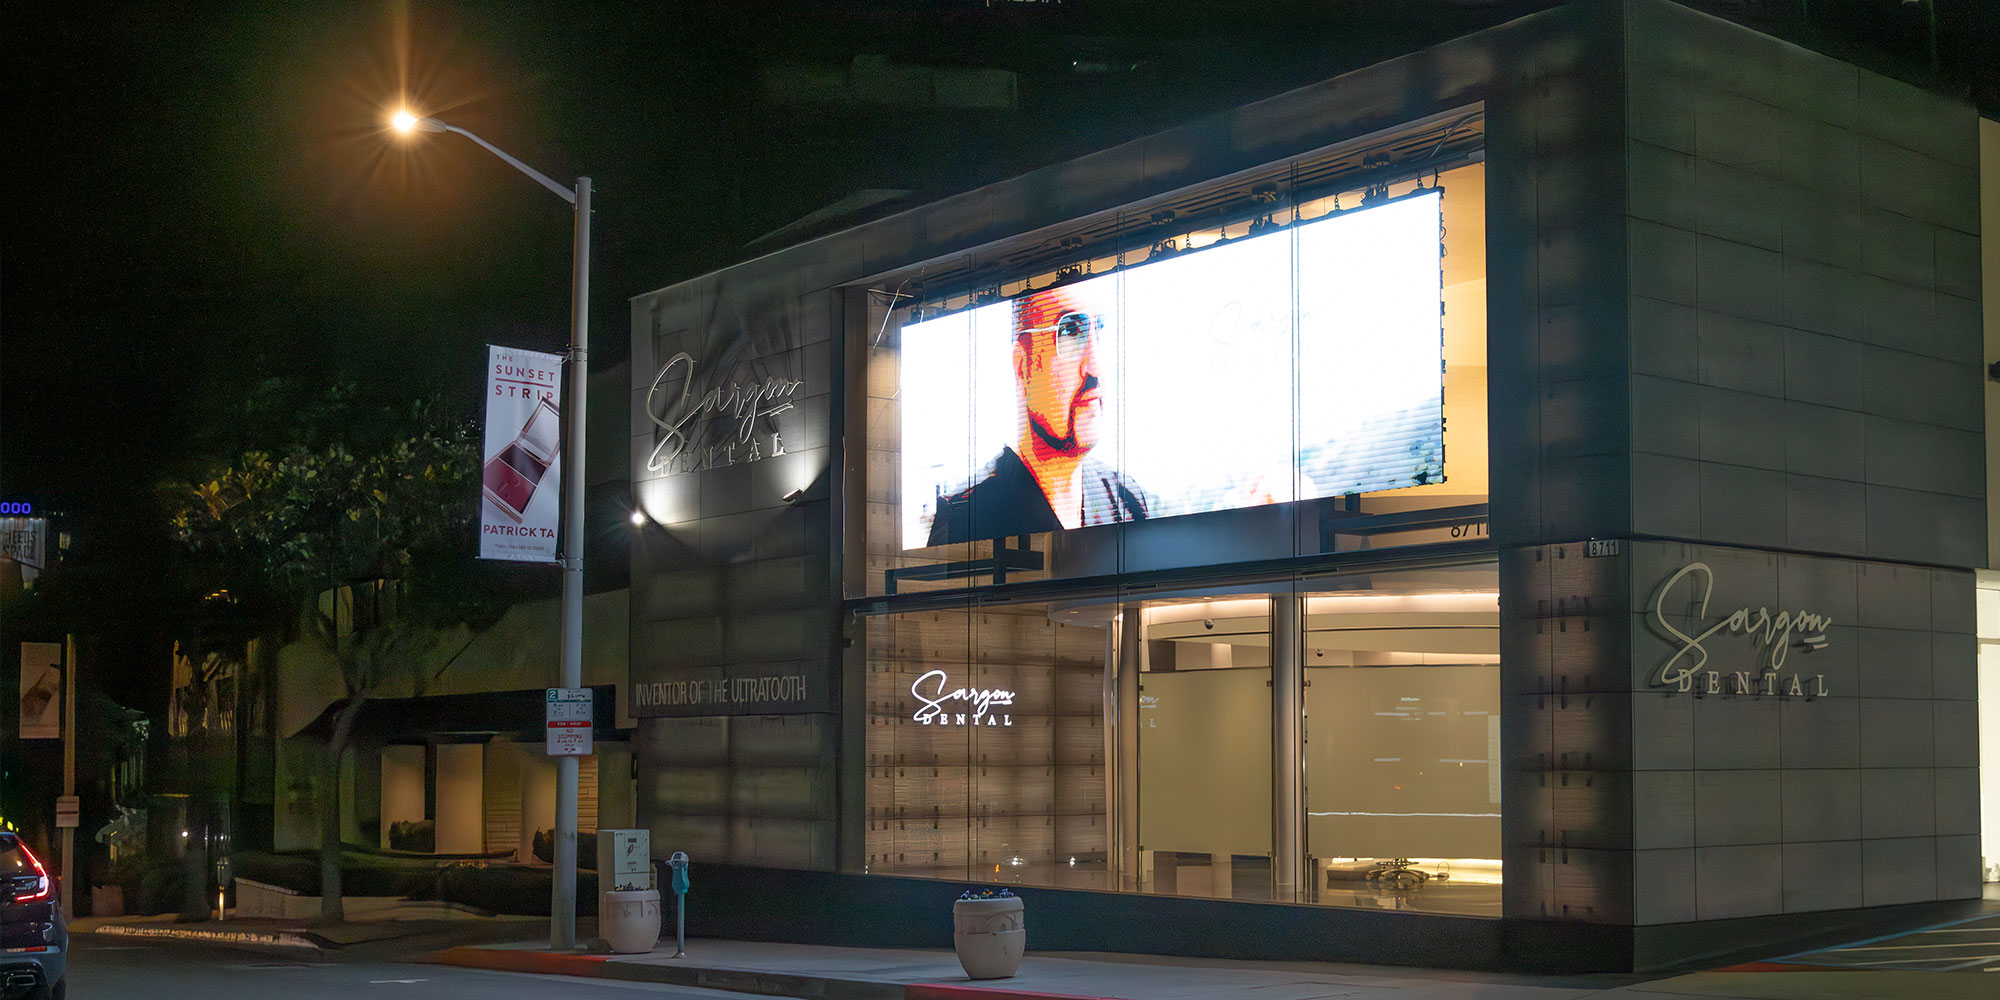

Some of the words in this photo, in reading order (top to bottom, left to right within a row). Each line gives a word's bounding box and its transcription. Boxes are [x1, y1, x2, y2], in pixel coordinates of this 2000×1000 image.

[496, 354, 513, 362] THE
[495, 364, 555, 382] SUNSET
[495, 384, 554, 400] STRIP
[483, 524, 537, 537] PATRICK
[539, 528, 555, 538] TA
[1591, 541, 1617, 556] 8711
[1656, 561, 1832, 684] Sargon
[1677, 668, 1829, 697] DENTAL
[549, 690, 556, 699] 2
[635, 681, 687, 707] INVENTOR
[689, 680, 703, 705] OF
[706, 678, 728, 703] THE
[731, 675, 806, 705] ULTRATOOTH
[911, 669, 1016, 721] Sargon
[922, 713, 1013, 726] DENTAL
